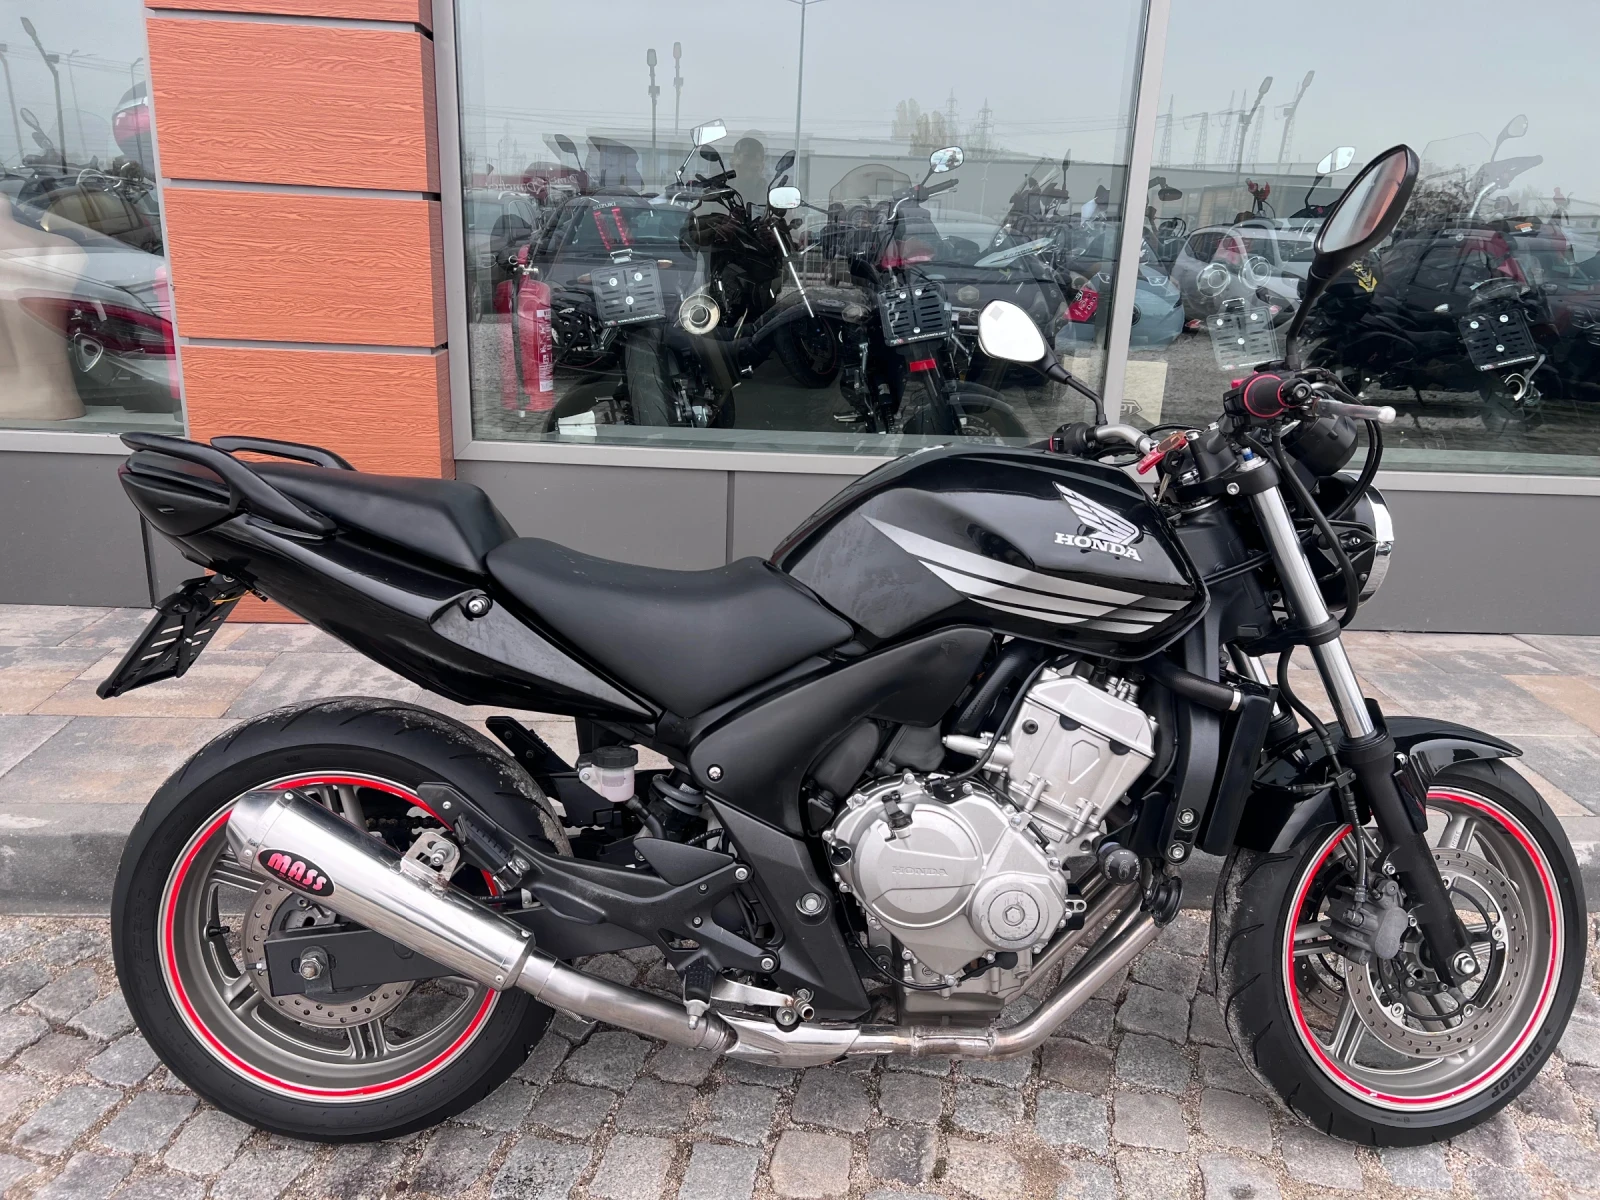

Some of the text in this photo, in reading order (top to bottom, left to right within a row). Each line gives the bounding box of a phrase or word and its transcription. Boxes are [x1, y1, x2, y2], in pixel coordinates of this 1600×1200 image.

[1054, 532, 1142, 561] HONDA
[267, 853, 327, 891] MASS
[891, 865, 949, 877] HONDA
[1491, 1041, 1543, 1099] DUNLOP
